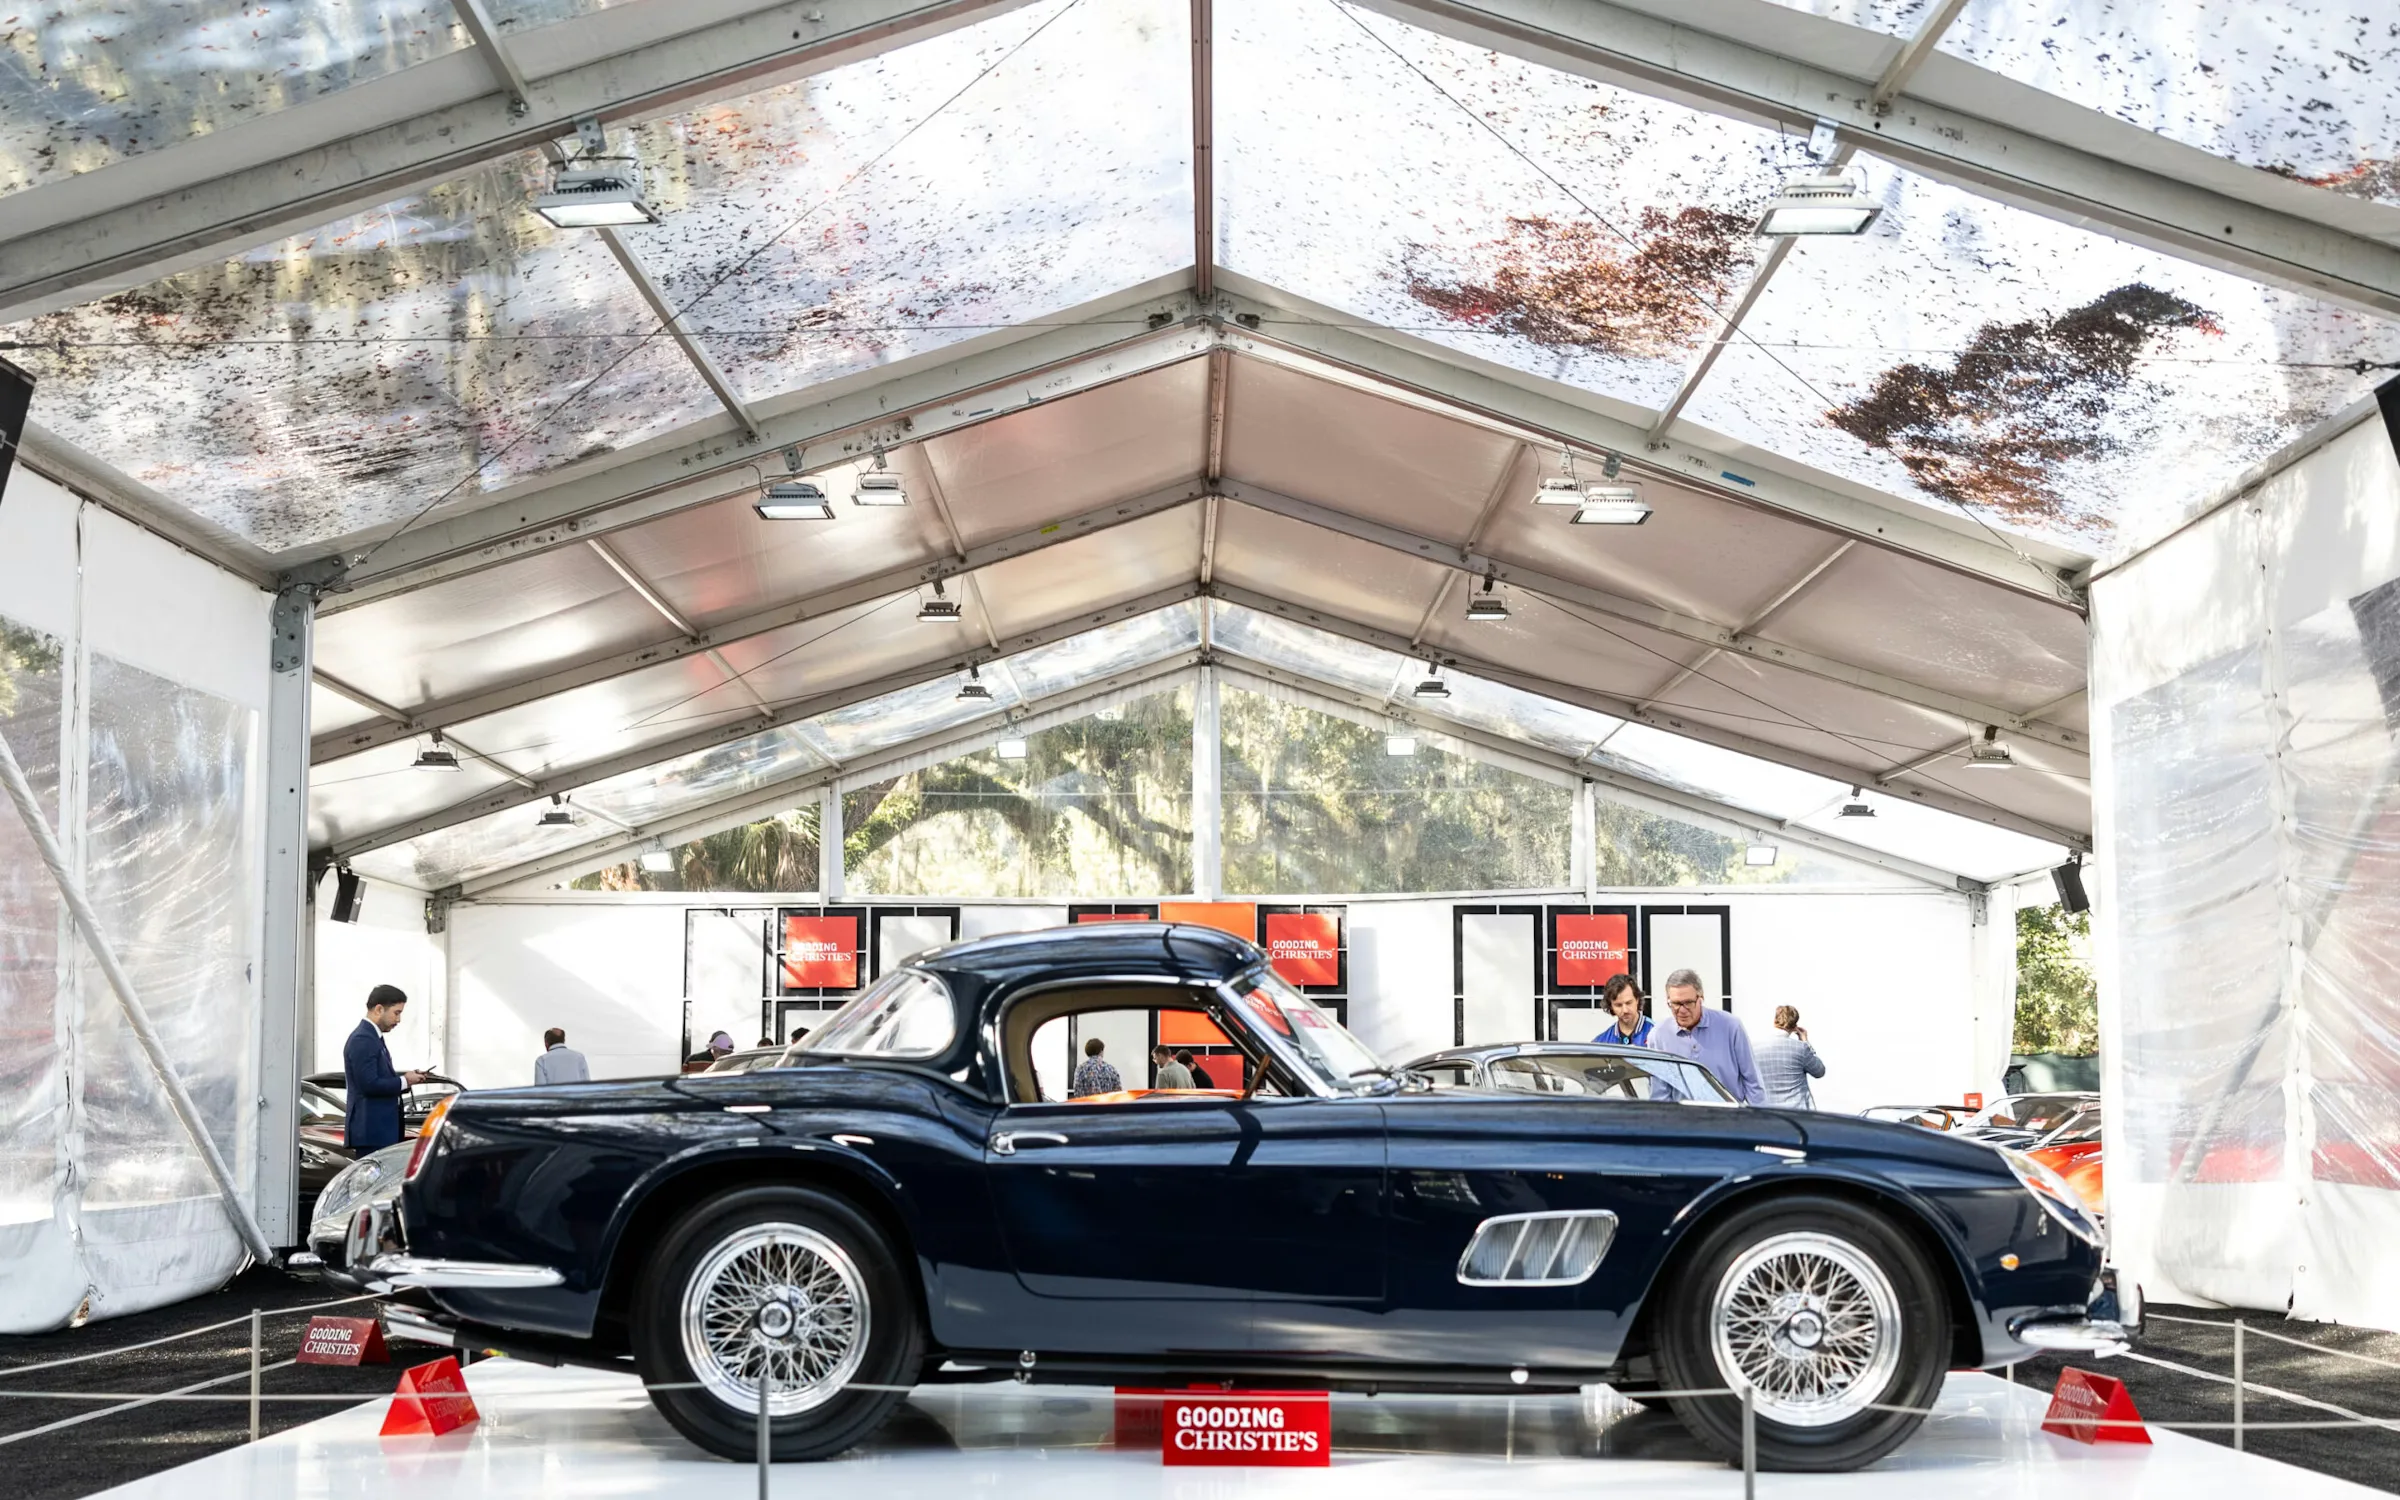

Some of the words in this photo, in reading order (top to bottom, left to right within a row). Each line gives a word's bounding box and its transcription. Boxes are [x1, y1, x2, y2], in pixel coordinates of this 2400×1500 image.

[791, 941, 838, 952] ODING
[1272, 940, 1319, 950] GOODING
[1562, 940, 1609, 950] GOODING
[1271, 950, 1333, 960] CHRISTIE'S
[1562, 950, 1624, 960] CHRISTIE'S
[309, 1327, 353, 1341] GOODING
[304, 1341, 361, 1356] CHRISTIE'S
[2057, 1382, 2093, 1407] GOODING
[1176, 1406, 1285, 1428] GOODING
[1174, 1428, 1319, 1452] CHRISTIE'S
